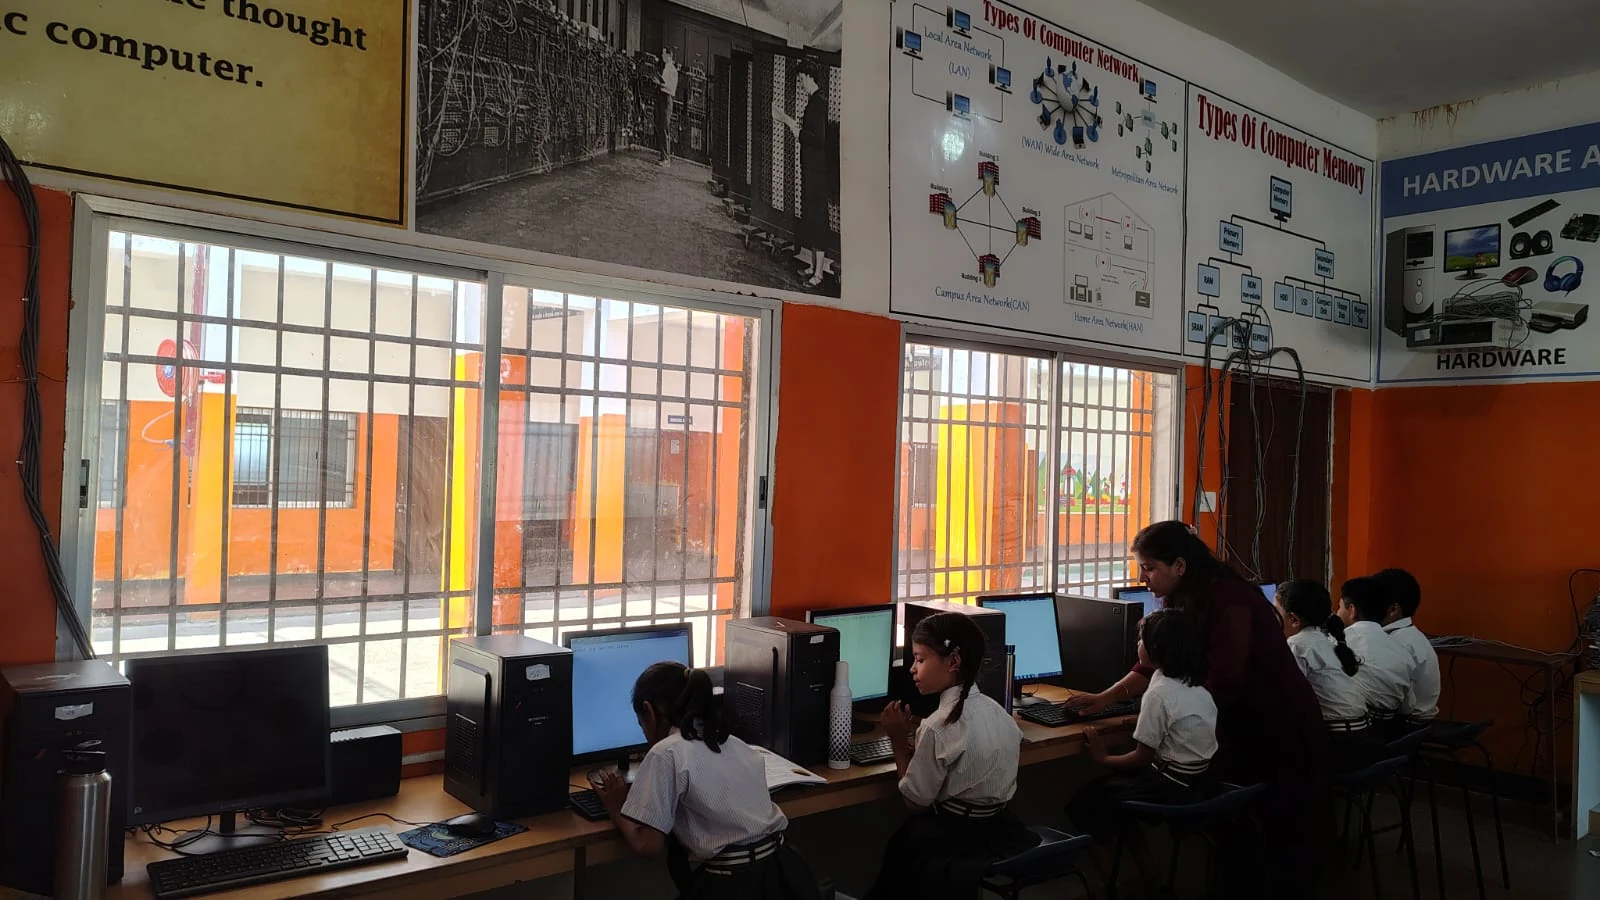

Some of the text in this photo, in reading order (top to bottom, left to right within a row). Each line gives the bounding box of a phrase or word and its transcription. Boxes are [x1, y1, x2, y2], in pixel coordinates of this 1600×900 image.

[224, 0, 367, 51] thought
[983, 0, 1139, 83] Types Of Computer Network
[46, 21, 263, 87] computer.
[924, 27, 992, 61] Local Area Network
[948, 61, 971, 80] (LAN)
[1021, 135, 1100, 170] (WAN) Wide Area Network
[1197, 93, 1366, 195] Types Of Computer Memory
[1111, 166, 1178, 195] Metropolitan Area Network
[1403, 149, 1571, 198] HARDWARE
[935, 287, 965, 302] Campus
[965, 291, 983, 303] Area
[1074, 312, 1090, 323] Home
[1090, 315, 1105, 326] Area
[1437, 348, 1566, 370] HARDWARE
